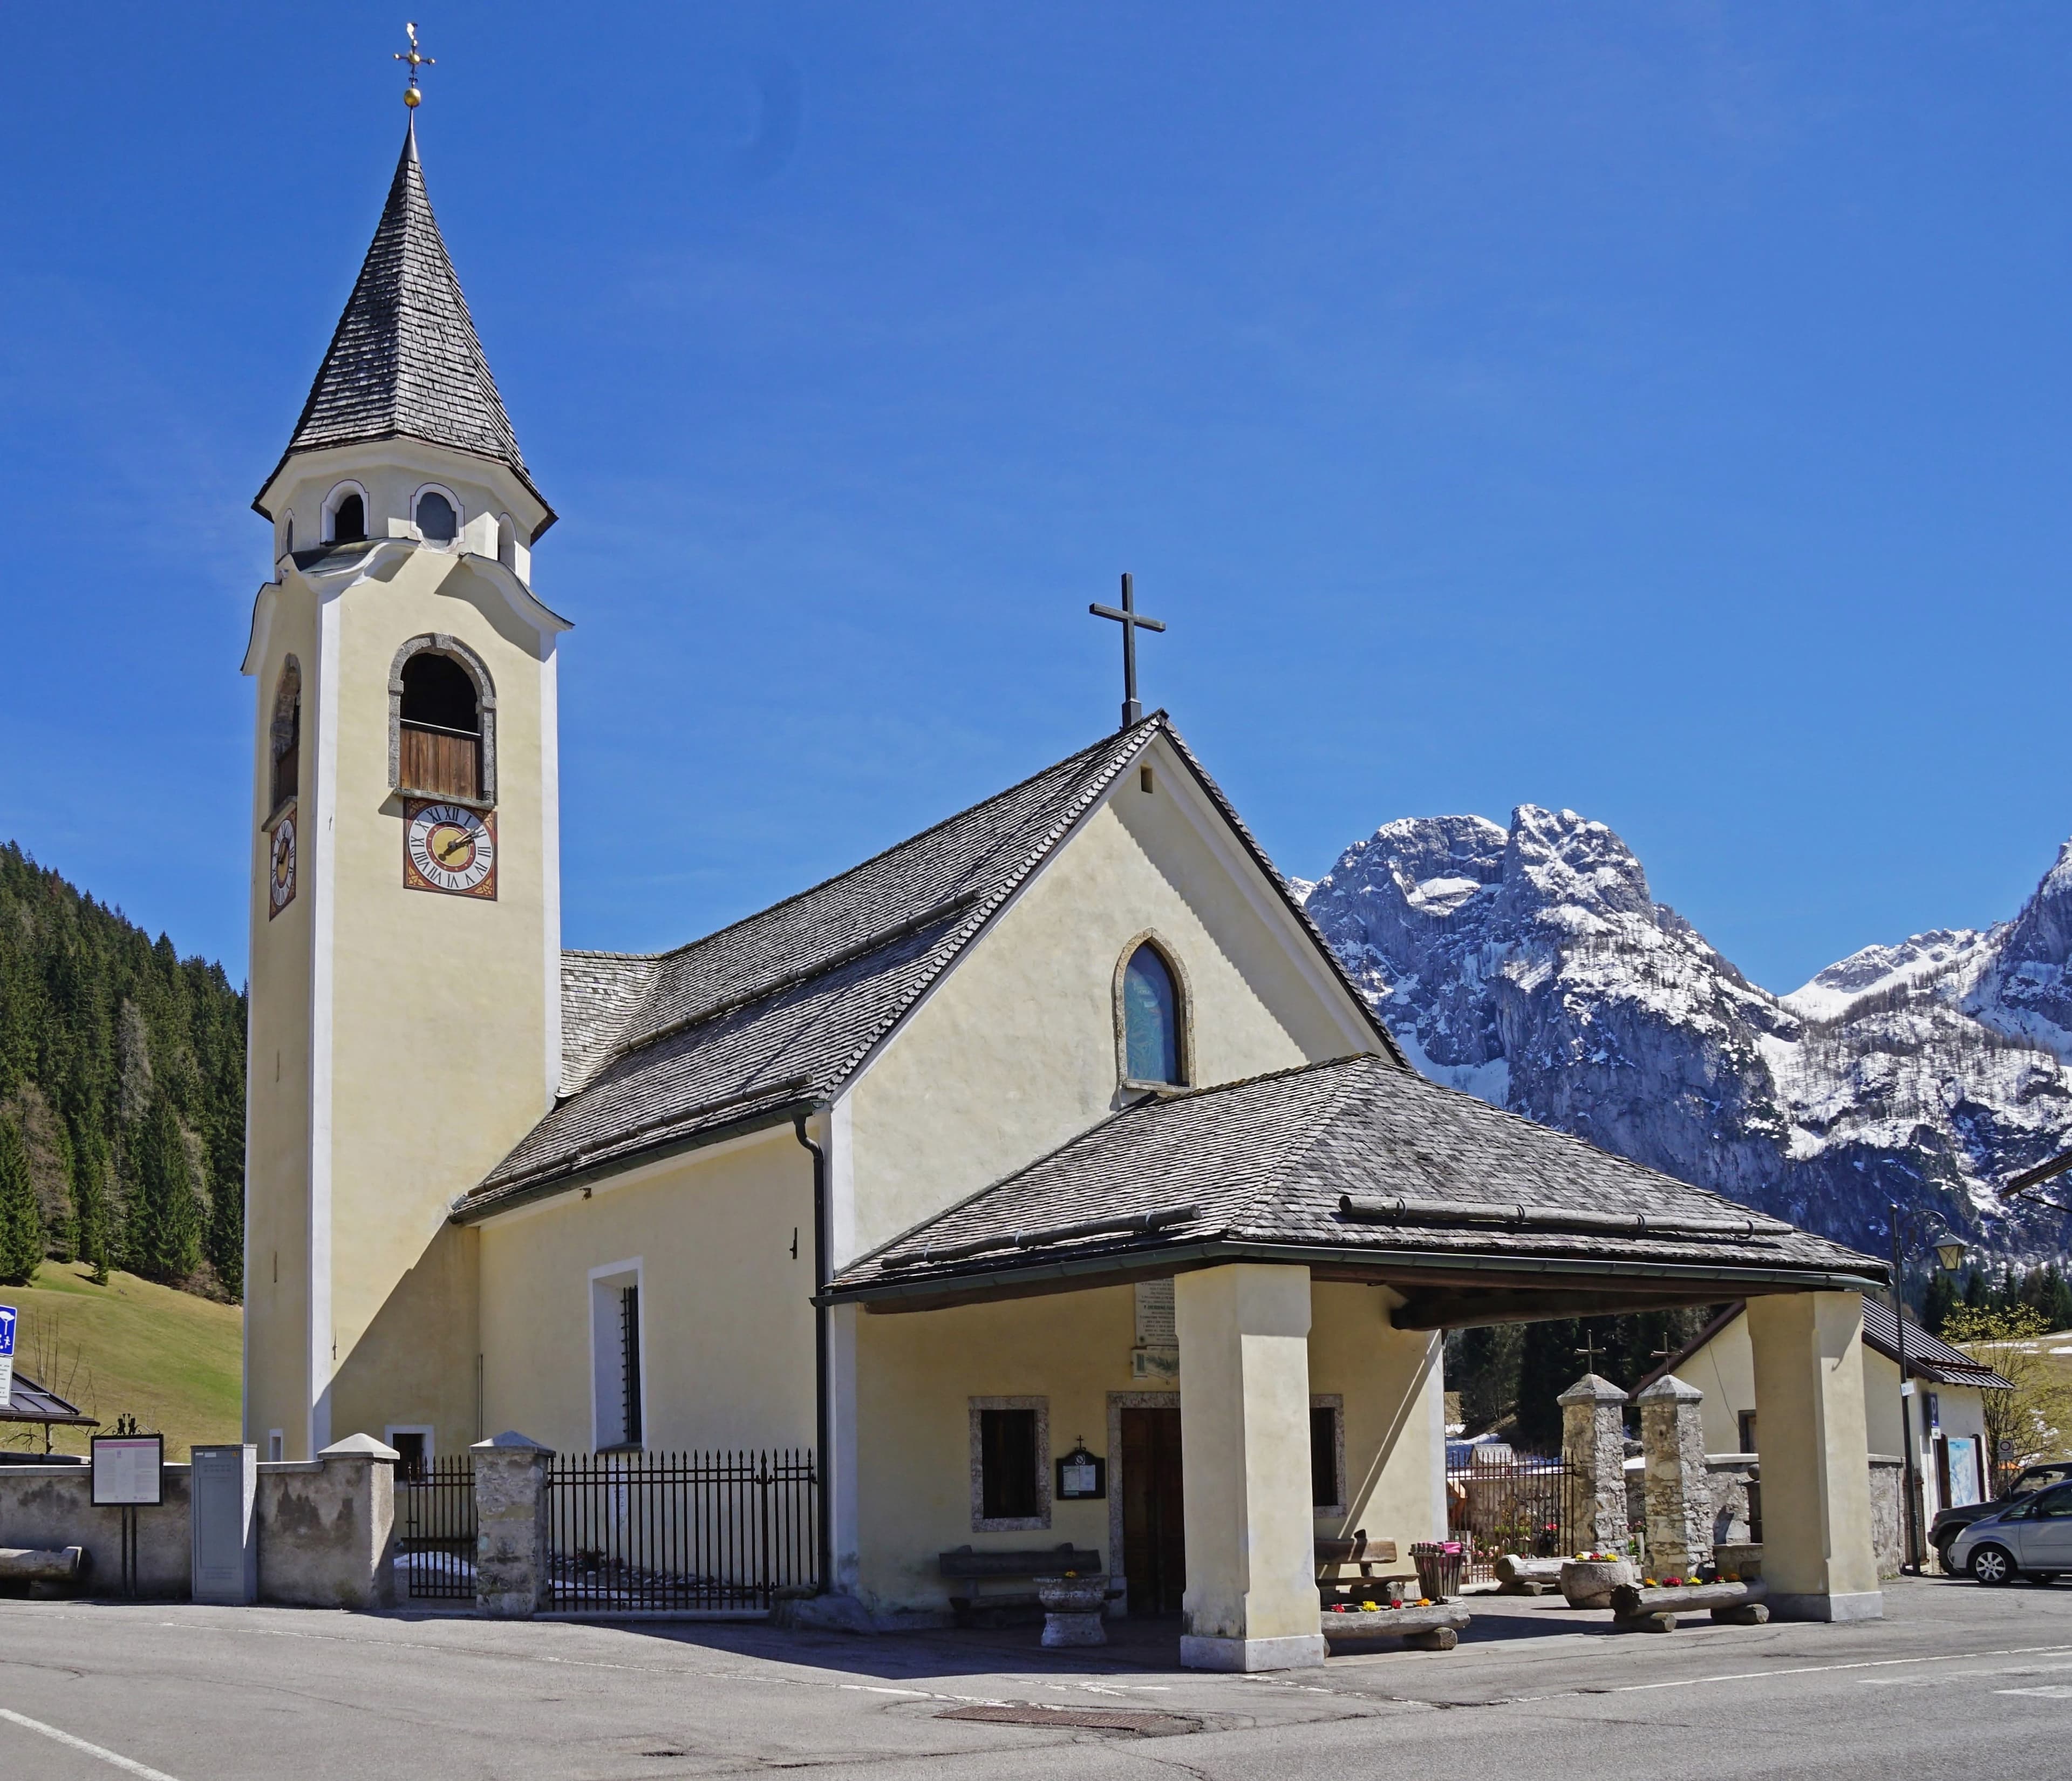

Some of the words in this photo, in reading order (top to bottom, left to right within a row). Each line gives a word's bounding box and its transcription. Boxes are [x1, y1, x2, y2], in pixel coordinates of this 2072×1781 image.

[426, 807, 441, 824] XI
[444, 806, 459, 821] XII
[414, 819, 430, 832] X
[410, 835, 425, 847] IX
[477, 846, 492, 858] III
[413, 851, 431, 872] VIII
[474, 861, 488, 877] IV
[426, 865, 442, 885] VII
[447, 873, 459, 888] VI
[464, 872, 476, 886] V
